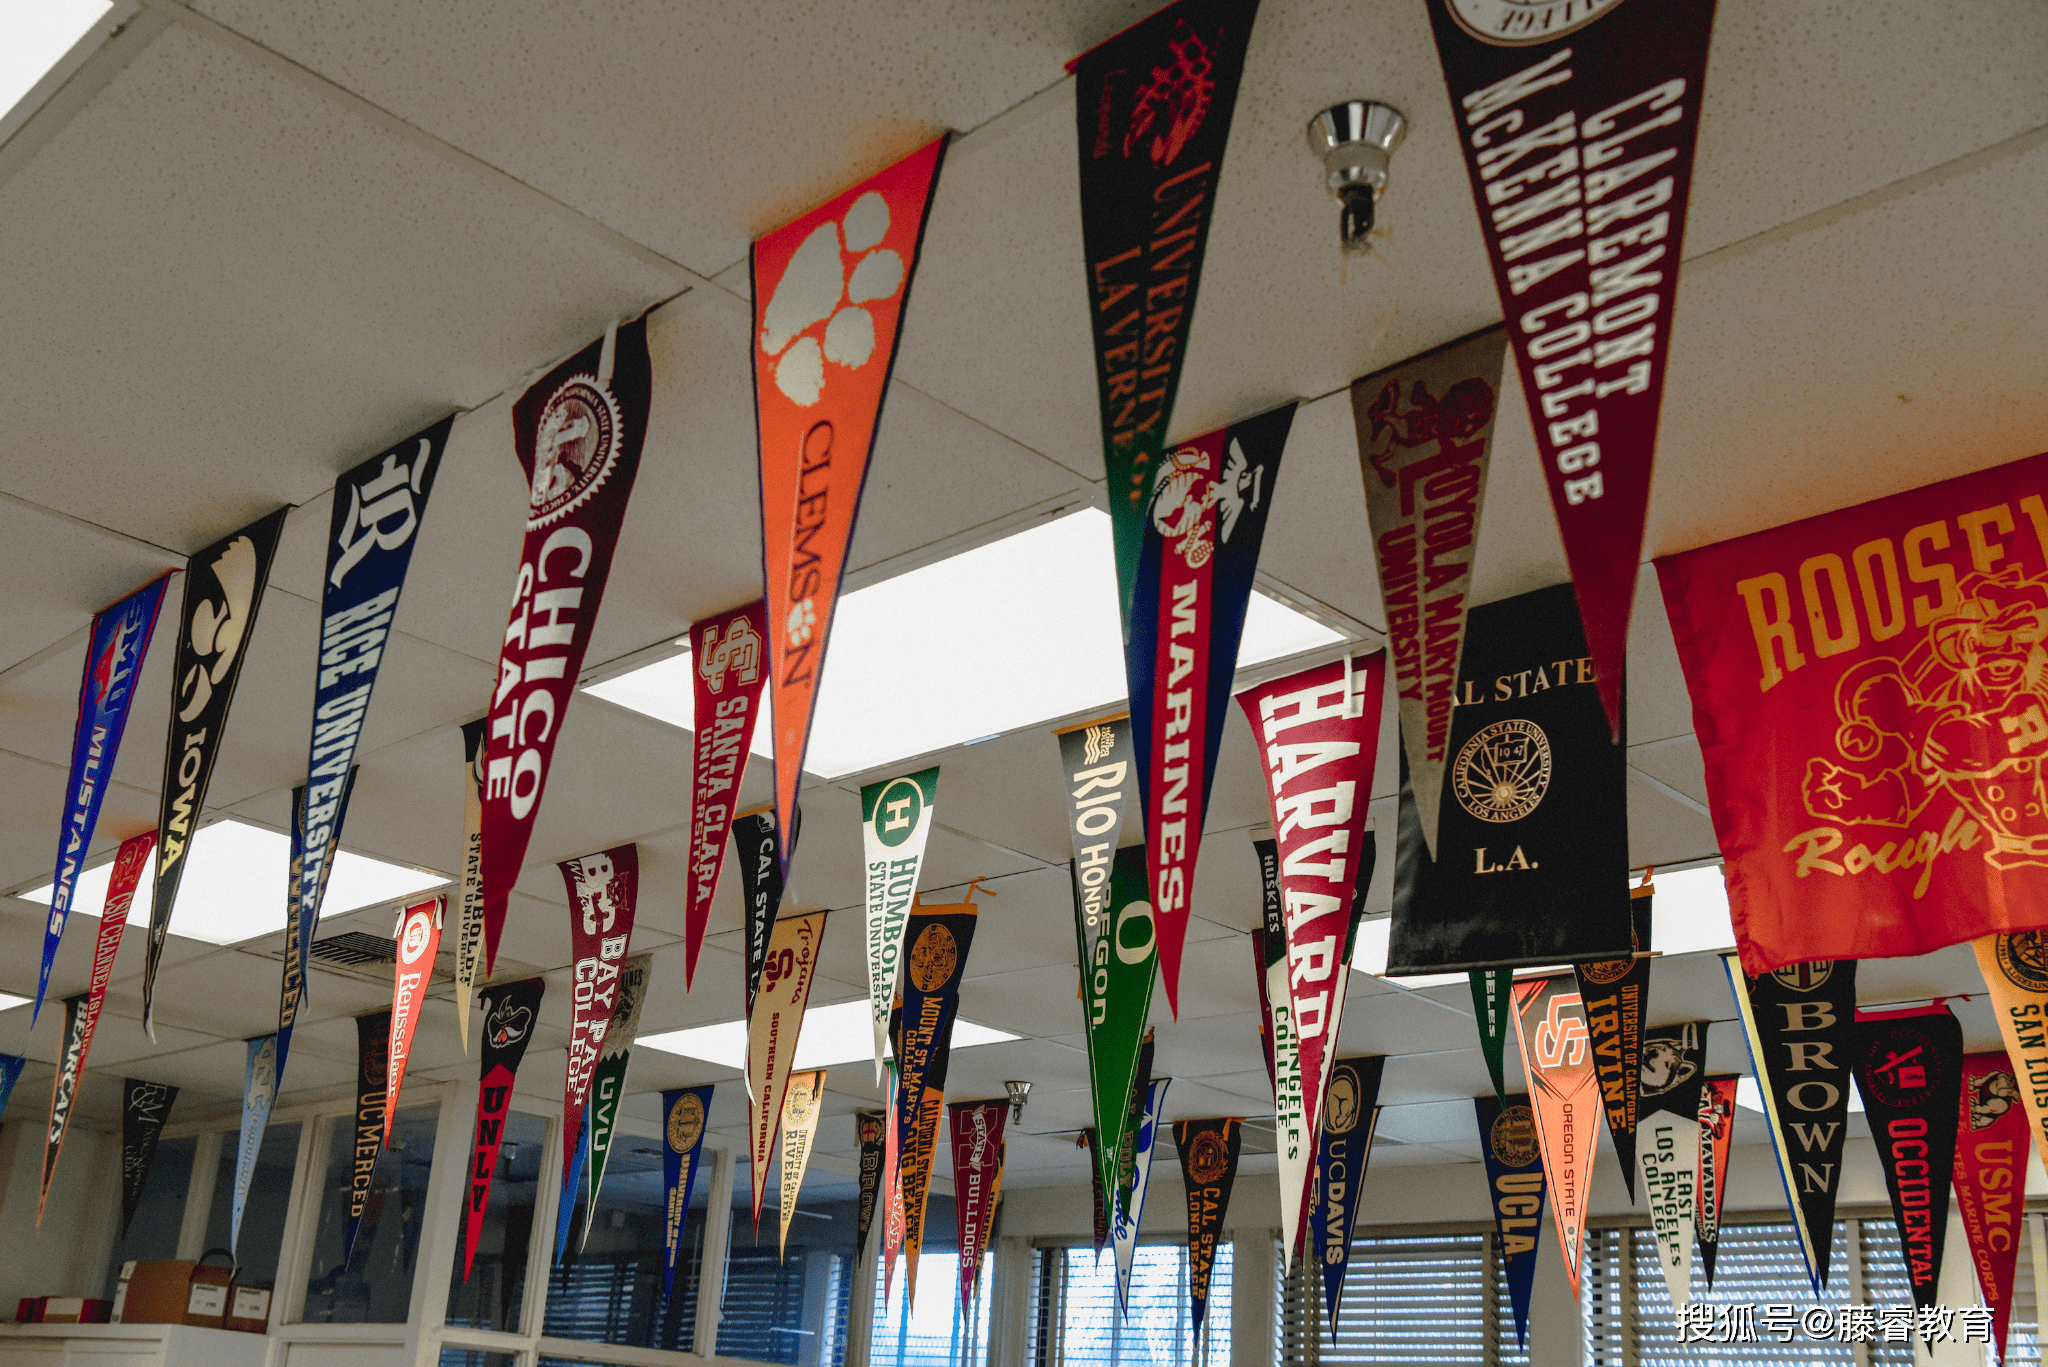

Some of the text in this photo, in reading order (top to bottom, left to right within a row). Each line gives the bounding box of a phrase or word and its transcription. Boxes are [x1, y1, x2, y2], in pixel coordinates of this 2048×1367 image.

[1137, 161, 1212, 434] UNIVERSITY
[1581, 78, 1686, 398] CLAREMONT
[1521, 292, 1604, 506] COLLEGE
[319, 586, 400, 689] RICE
[1378, 523, 1423, 702] UNIVERSITY
[486, 562, 535, 801] STATE
[510, 526, 593, 820] CHICO
[1494, 656, 1598, 703] STATE
[160, 727, 206, 877] IOWA
[302, 682, 371, 912] UNIVERSITY
[692, 726, 712, 875] UNIVERSITY
[696, 695, 749, 904] SANTA CLARA
[1157, 579, 1198, 914] MARINES
[1456, 721, 1551, 799] CALIFORNIA STATE UNIVERSITY
[50, 724, 106, 938] MUSTANGS
[757, 838, 774, 885] CAL
[885, 796, 911, 833] H
[1072, 760, 1127, 926] RIO HONDO
[1259, 669, 1367, 1040] HARVARD
[1468, 793, 1540, 821] LOS ANGELES
[1474, 845, 1540, 875] L.A.
[1783, 807, 1985, 900] Rough
[104, 892, 134, 922] CSU
[459, 833, 481, 984] STATE UNIVERSITY
[753, 891, 767, 964] STATE
[869, 861, 886, 1025] STATE UNIVERSITY
[880, 854, 918, 1023] HUMBOLDT
[1264, 854, 1280, 933] HUSKIES
[91, 924, 124, 993] CHANNEL
[790, 919, 813, 1006] Trojans
[1092, 882, 1111, 1026] REGON
[50, 1000, 88, 1144] BEARCATS
[567, 956, 598, 1093] COLLEGE
[574, 934, 628, 1107] BAY PATH
[902, 1029, 917, 1089] COLLEGE
[917, 996, 943, 1045] MOUNT
[1276, 1006, 1289, 1129] COLLEGE
[1587, 995, 1626, 1130] IRVINE
[1621, 984, 1639, 1135] UNIVERSITY OF CALIFORNIA
[2010, 1004, 2048, 1108] SAN LUIS
[757, 1012, 780, 1163] SOUTHERN CALIFORNIA
[971, 1112, 986, 1161] STATE
[1776, 1001, 1840, 1194] BROWN
[351, 1091, 387, 1218] UC MERCED
[473, 1086, 508, 1213] UNLV
[668, 1187, 677, 1219] SANTA
[674, 1154, 691, 1227] UNIVERSITY
[793, 1171, 799, 1180] OF
[794, 1129, 808, 1170] UNIVERSITY
[901, 1114, 918, 1242] ONG BEACH
[911, 1100, 940, 1250] CALIFORNIA STATE UNIVERSITY
[1119, 1130, 1134, 1189] POLY
[1563, 1103, 1575, 1218] OREGON STATE
[1642, 1153, 1668, 1245] COLLEGE
[1655, 1126, 1681, 1267] LOS ANGELES
[1677, 1170, 1693, 1222] EAST
[1701, 1128, 1717, 1243] MATADORS
[1888, 1117, 1932, 1287] OCCIDENTAL
[1974, 1141, 2014, 1253] USMC
[963, 1173, 981, 1268] BULLDOGS
[1189, 1191, 1200, 1296] LONG BEACH
[1197, 1187, 1220, 1300] CAL STATE
[1496, 1172, 1543, 1255] UCLA
[1960, 1185, 1984, 1245] MARINE
[1977, 1249, 2000, 1301] CORPS
